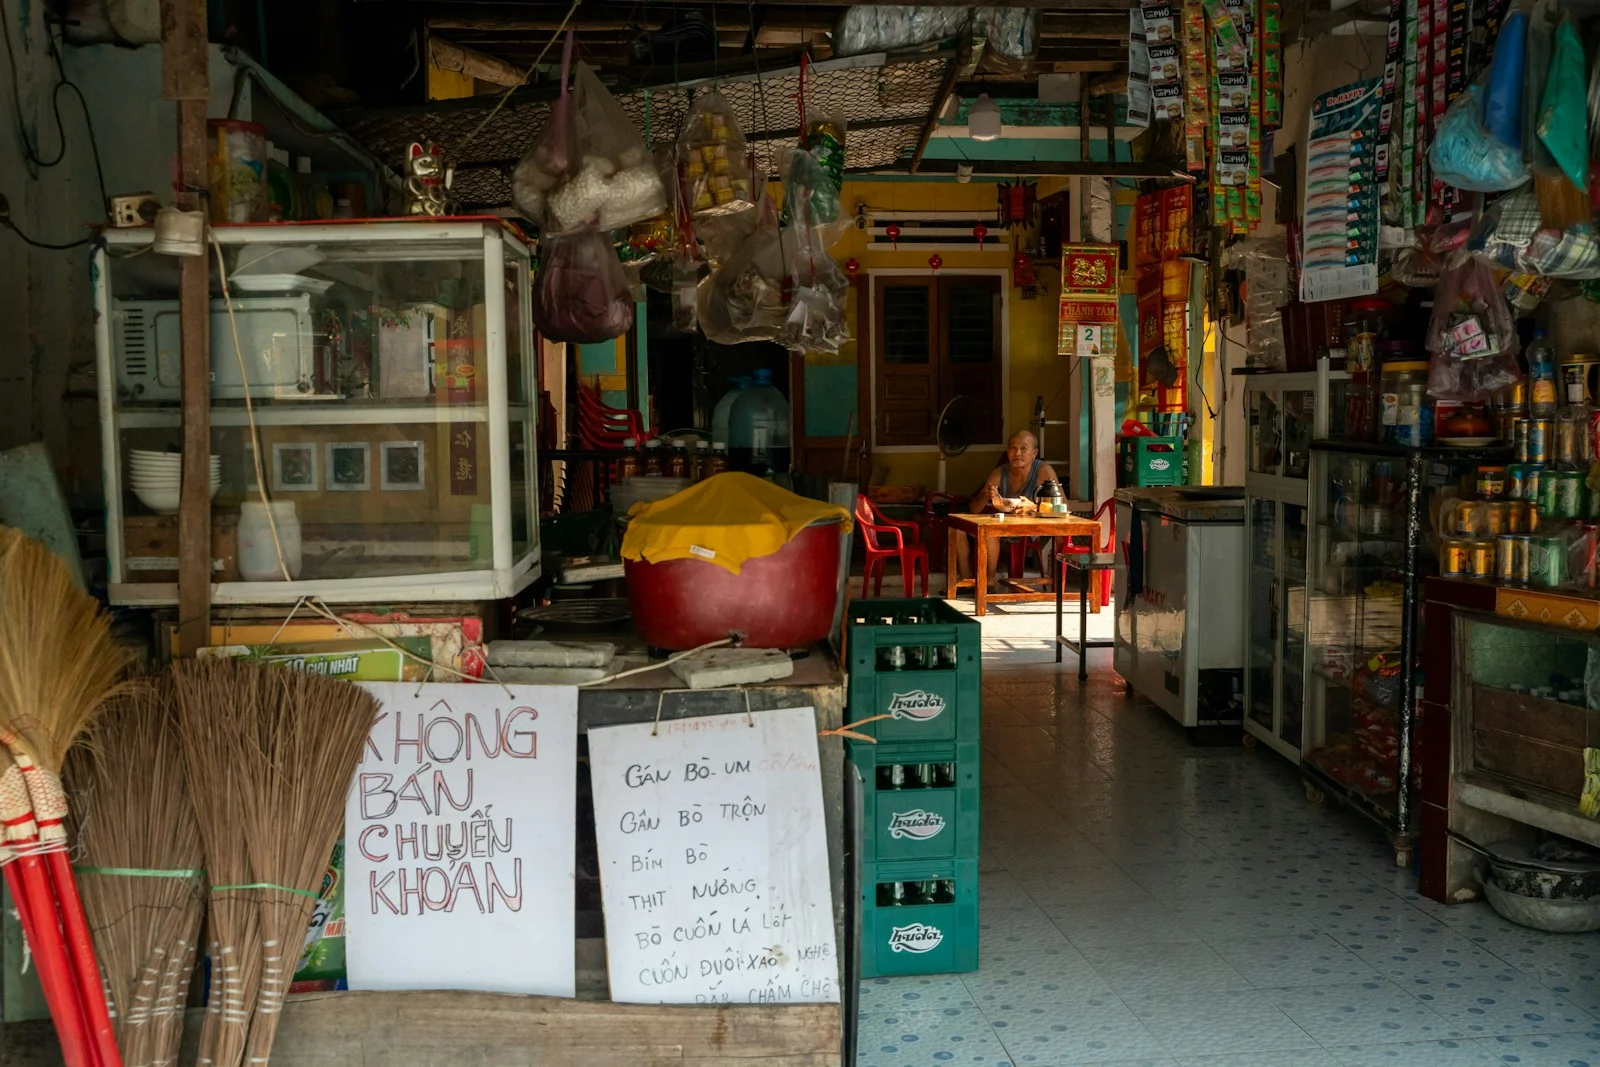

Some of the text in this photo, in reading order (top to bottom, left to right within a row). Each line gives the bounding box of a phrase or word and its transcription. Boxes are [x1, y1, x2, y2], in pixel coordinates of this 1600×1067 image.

[1085, 328, 1093, 341] 2
[360, 762, 473, 820] BÁN
[719, 795, 766, 821] TRỘN
